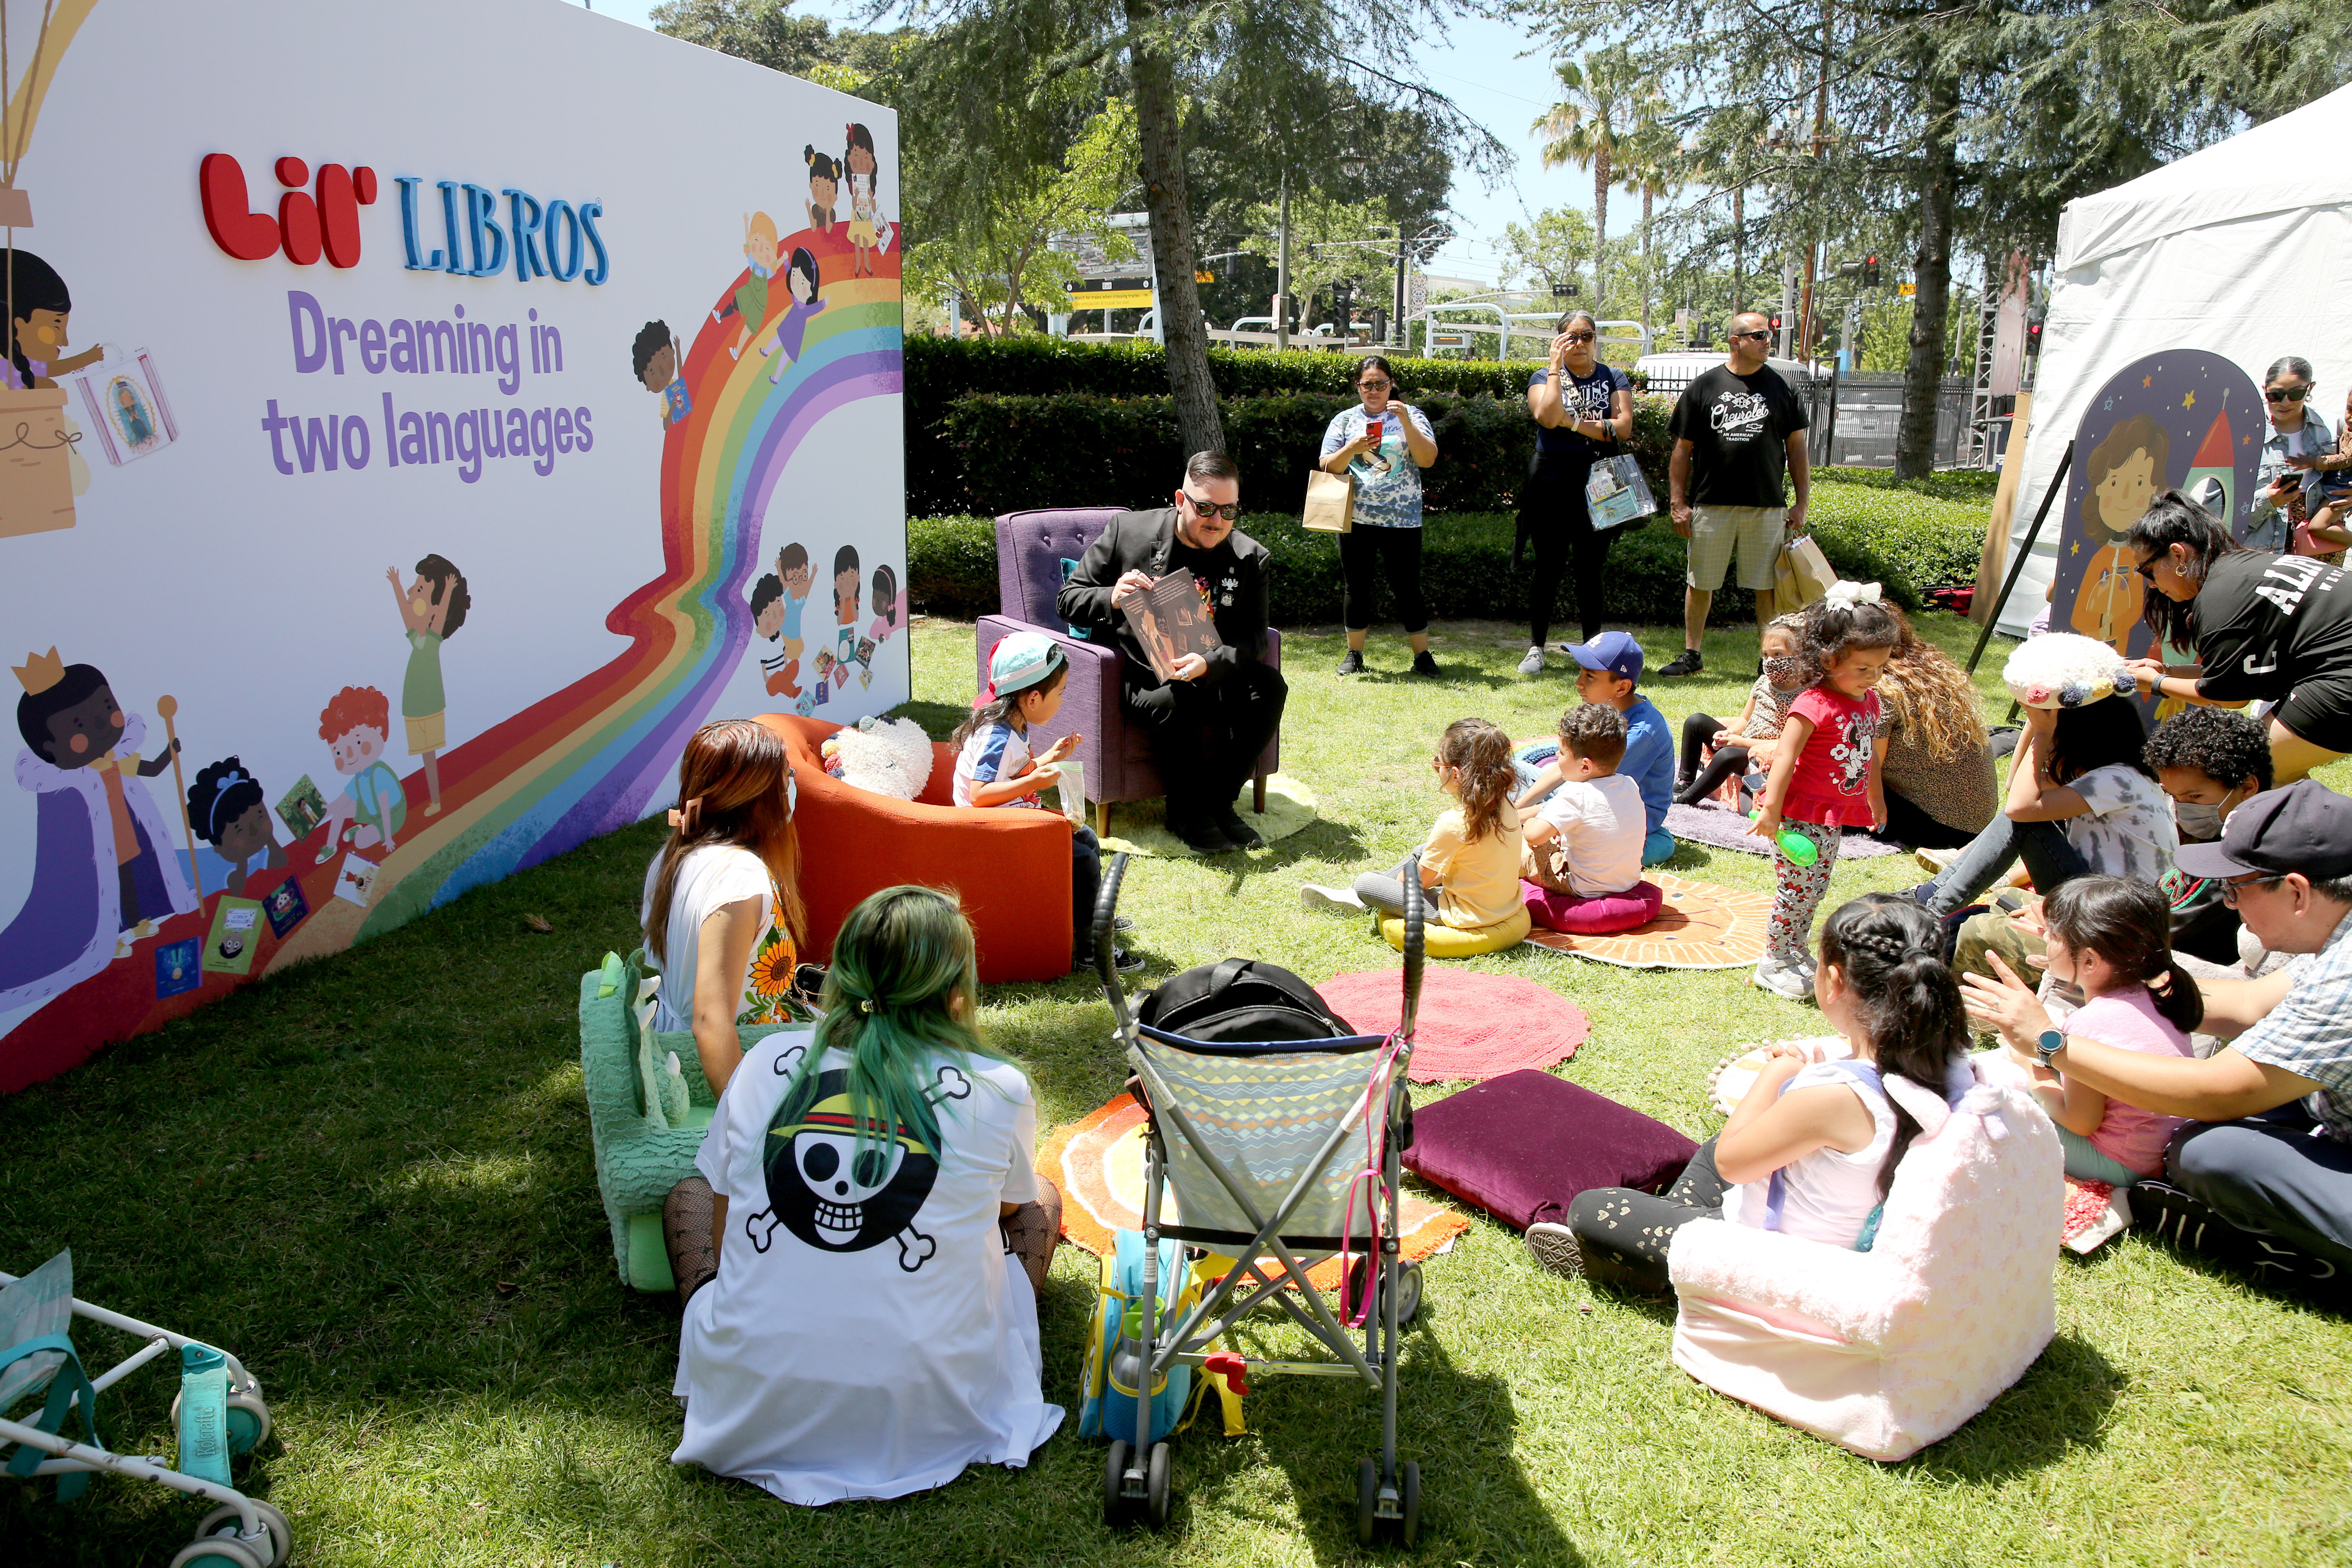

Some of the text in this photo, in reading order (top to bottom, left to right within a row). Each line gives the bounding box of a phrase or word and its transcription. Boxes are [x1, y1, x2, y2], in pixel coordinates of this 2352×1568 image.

[287, 290, 563, 395] Dreaming in
[1561, 380, 1609, 406] BUINS
[1711, 403, 1769, 430] Chevrolet
[261, 392, 593, 483] two languages
[1842, 720, 1854, 743] MINNIE
[196, 1414, 216, 1457] Kolcraft
